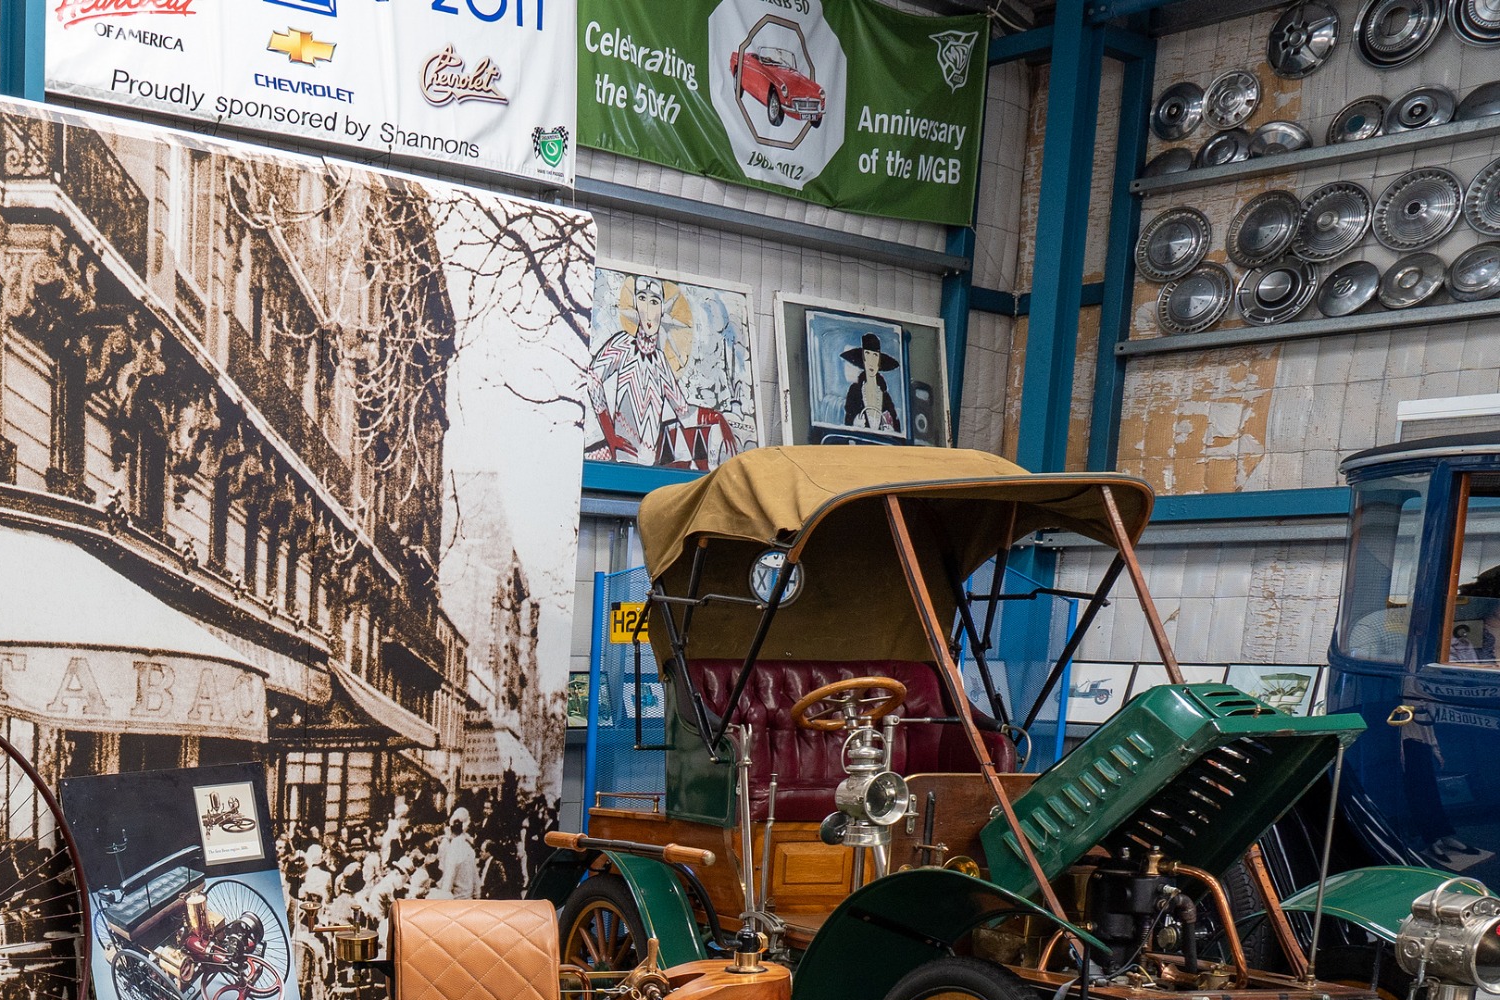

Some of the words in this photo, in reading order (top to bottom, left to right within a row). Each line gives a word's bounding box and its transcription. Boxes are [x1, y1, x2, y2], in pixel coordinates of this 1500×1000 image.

[94, 22, 114, 38] OF
[115, 28, 185, 52] AMERICA
[431, 0, 544, 31] 011
[421, 43, 510, 107] Chevrolet
[585, 20, 699, 91] Celebrating
[254, 73, 355, 104] CHEVROLET
[595, 73, 628, 109] the
[633, 82, 682, 125] 50th
[110, 69, 205, 111] Proudly
[215, 95, 338, 132] sponsored
[345, 115, 371, 142] by
[380, 121, 480, 159] Shannons
[857, 105, 967, 150] Anniversary
[858, 147, 880, 175] of
[886, 150, 912, 179] the
[917, 153, 962, 186] MGB
